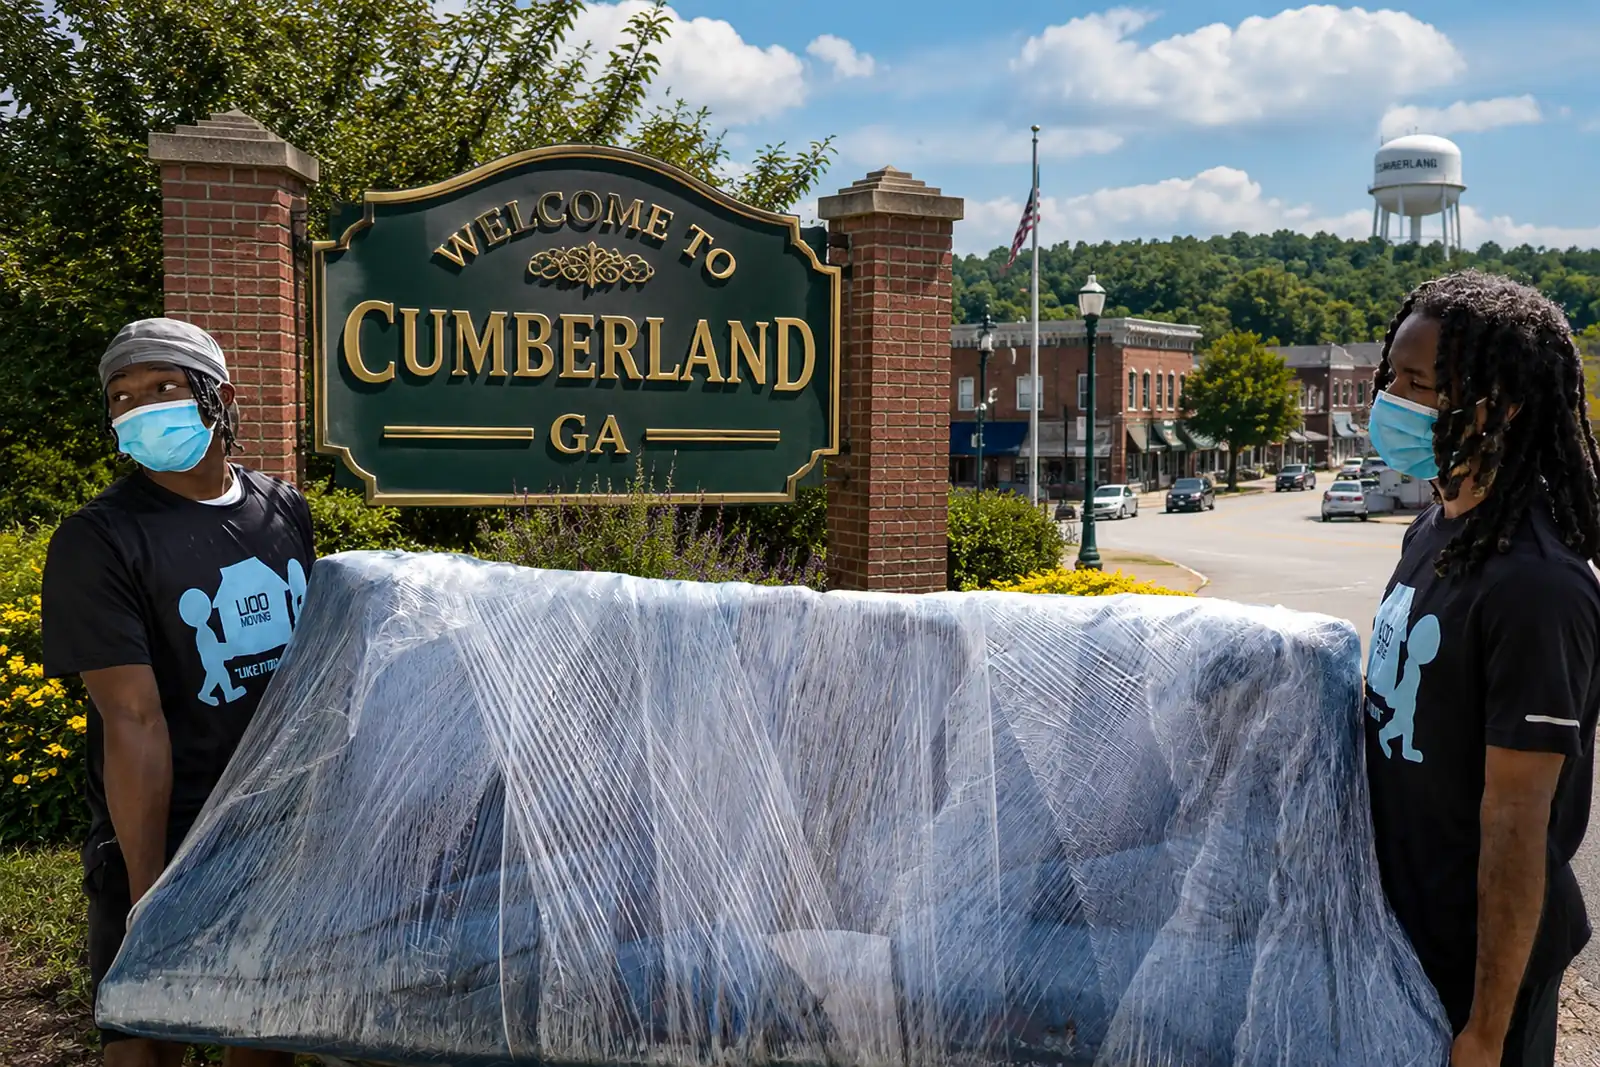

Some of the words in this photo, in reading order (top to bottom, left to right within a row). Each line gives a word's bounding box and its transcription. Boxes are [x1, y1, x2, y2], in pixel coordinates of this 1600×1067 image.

[433, 191, 675, 267] WELCOME
[683, 223, 737, 280] TO
[343, 299, 816, 392] CUMBERLAND
[550, 413, 631, 455] GA
[240, 611, 272, 628] MOVING
